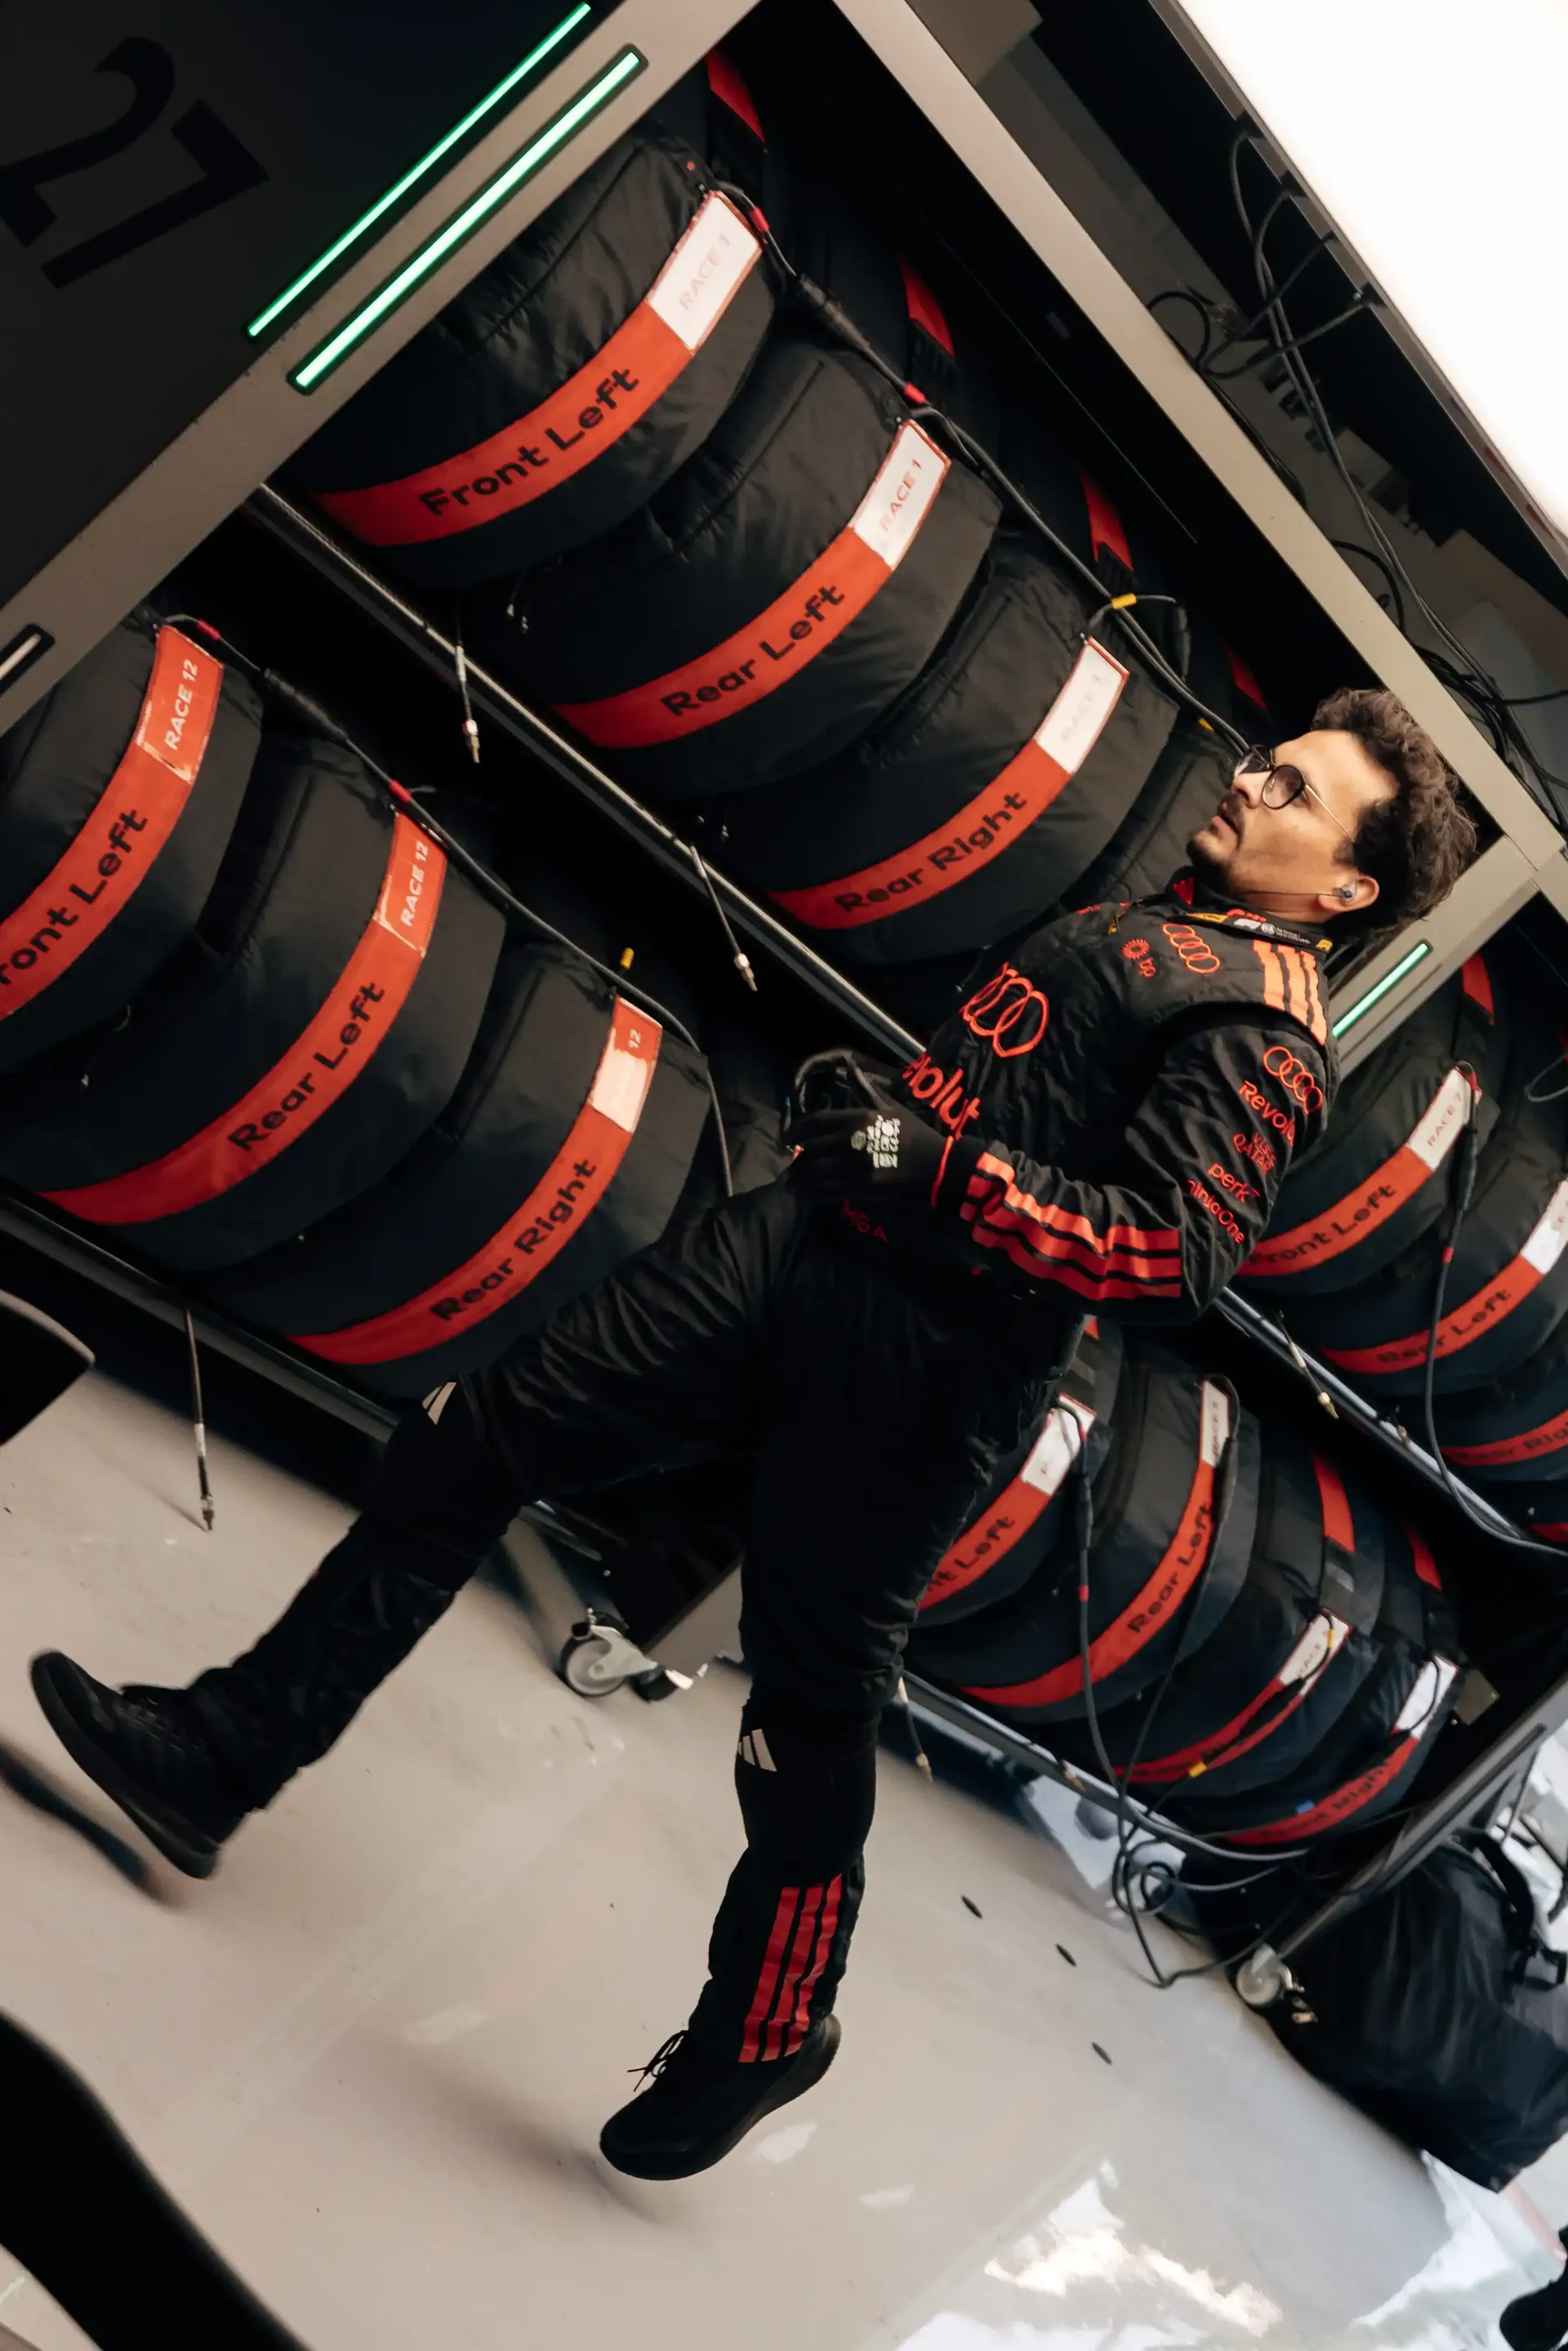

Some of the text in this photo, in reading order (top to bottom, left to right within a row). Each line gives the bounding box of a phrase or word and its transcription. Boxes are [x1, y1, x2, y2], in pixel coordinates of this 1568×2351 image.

[0, 36, 269, 289] 27
[679, 245, 721, 310] RACE
[419, 368, 639, 516] Front Left
[879, 470, 916, 532] RACE
[660, 585, 845, 717] Rear Left
[164, 658, 198, 751] RACE 12
[0, 809, 149, 986] ront Left
[399, 839, 430, 928] RACE 12
[834, 791, 1027, 912] Rear Right
[227, 982, 385, 1151] Rear Left
[627, 1028, 642, 1049] 12
[1206, 1162, 1251, 1204] perk
[1331, 1184, 1397, 1236] Left
[429, 1160, 597, 1322] Rear Right
[1450, 1289, 1512, 1335] Left
[953, 1516, 1015, 1570] Left
[1127, 1503, 1211, 1632] Rear Left
